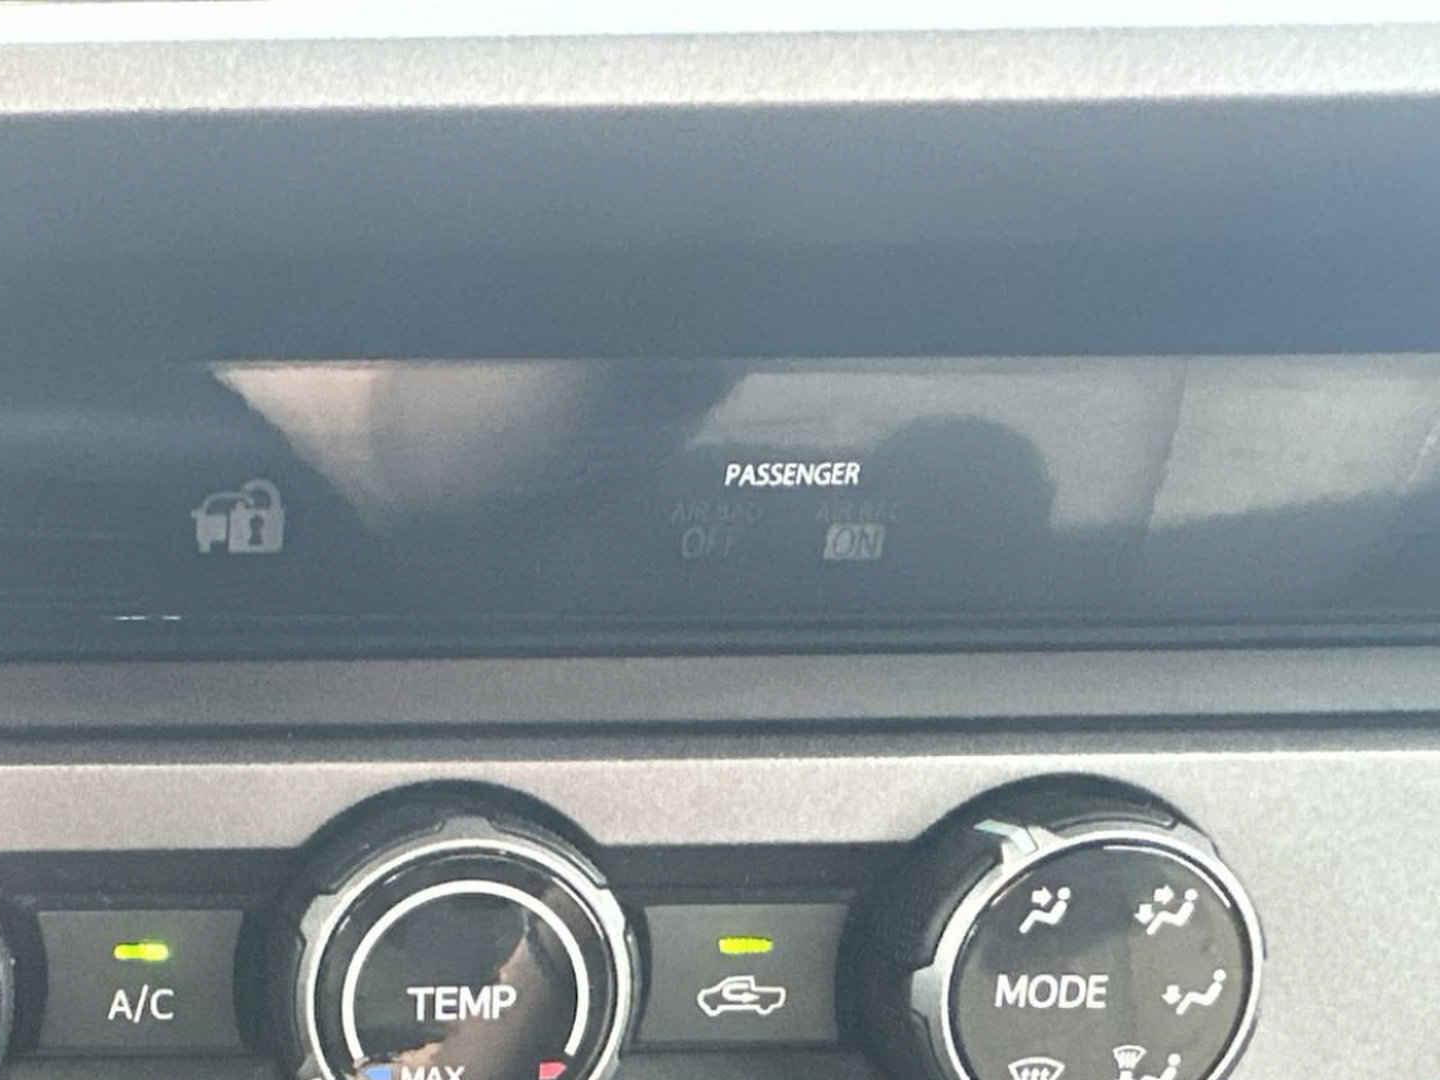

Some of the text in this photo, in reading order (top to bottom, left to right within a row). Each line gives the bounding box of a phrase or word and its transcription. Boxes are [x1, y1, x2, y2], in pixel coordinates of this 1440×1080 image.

[724, 462, 861, 487] PASSENGER
[833, 525, 881, 560] ON
[106, 984, 175, 1023] A/C
[406, 984, 517, 1021] TEMP
[994, 973, 1110, 1010] MODE
